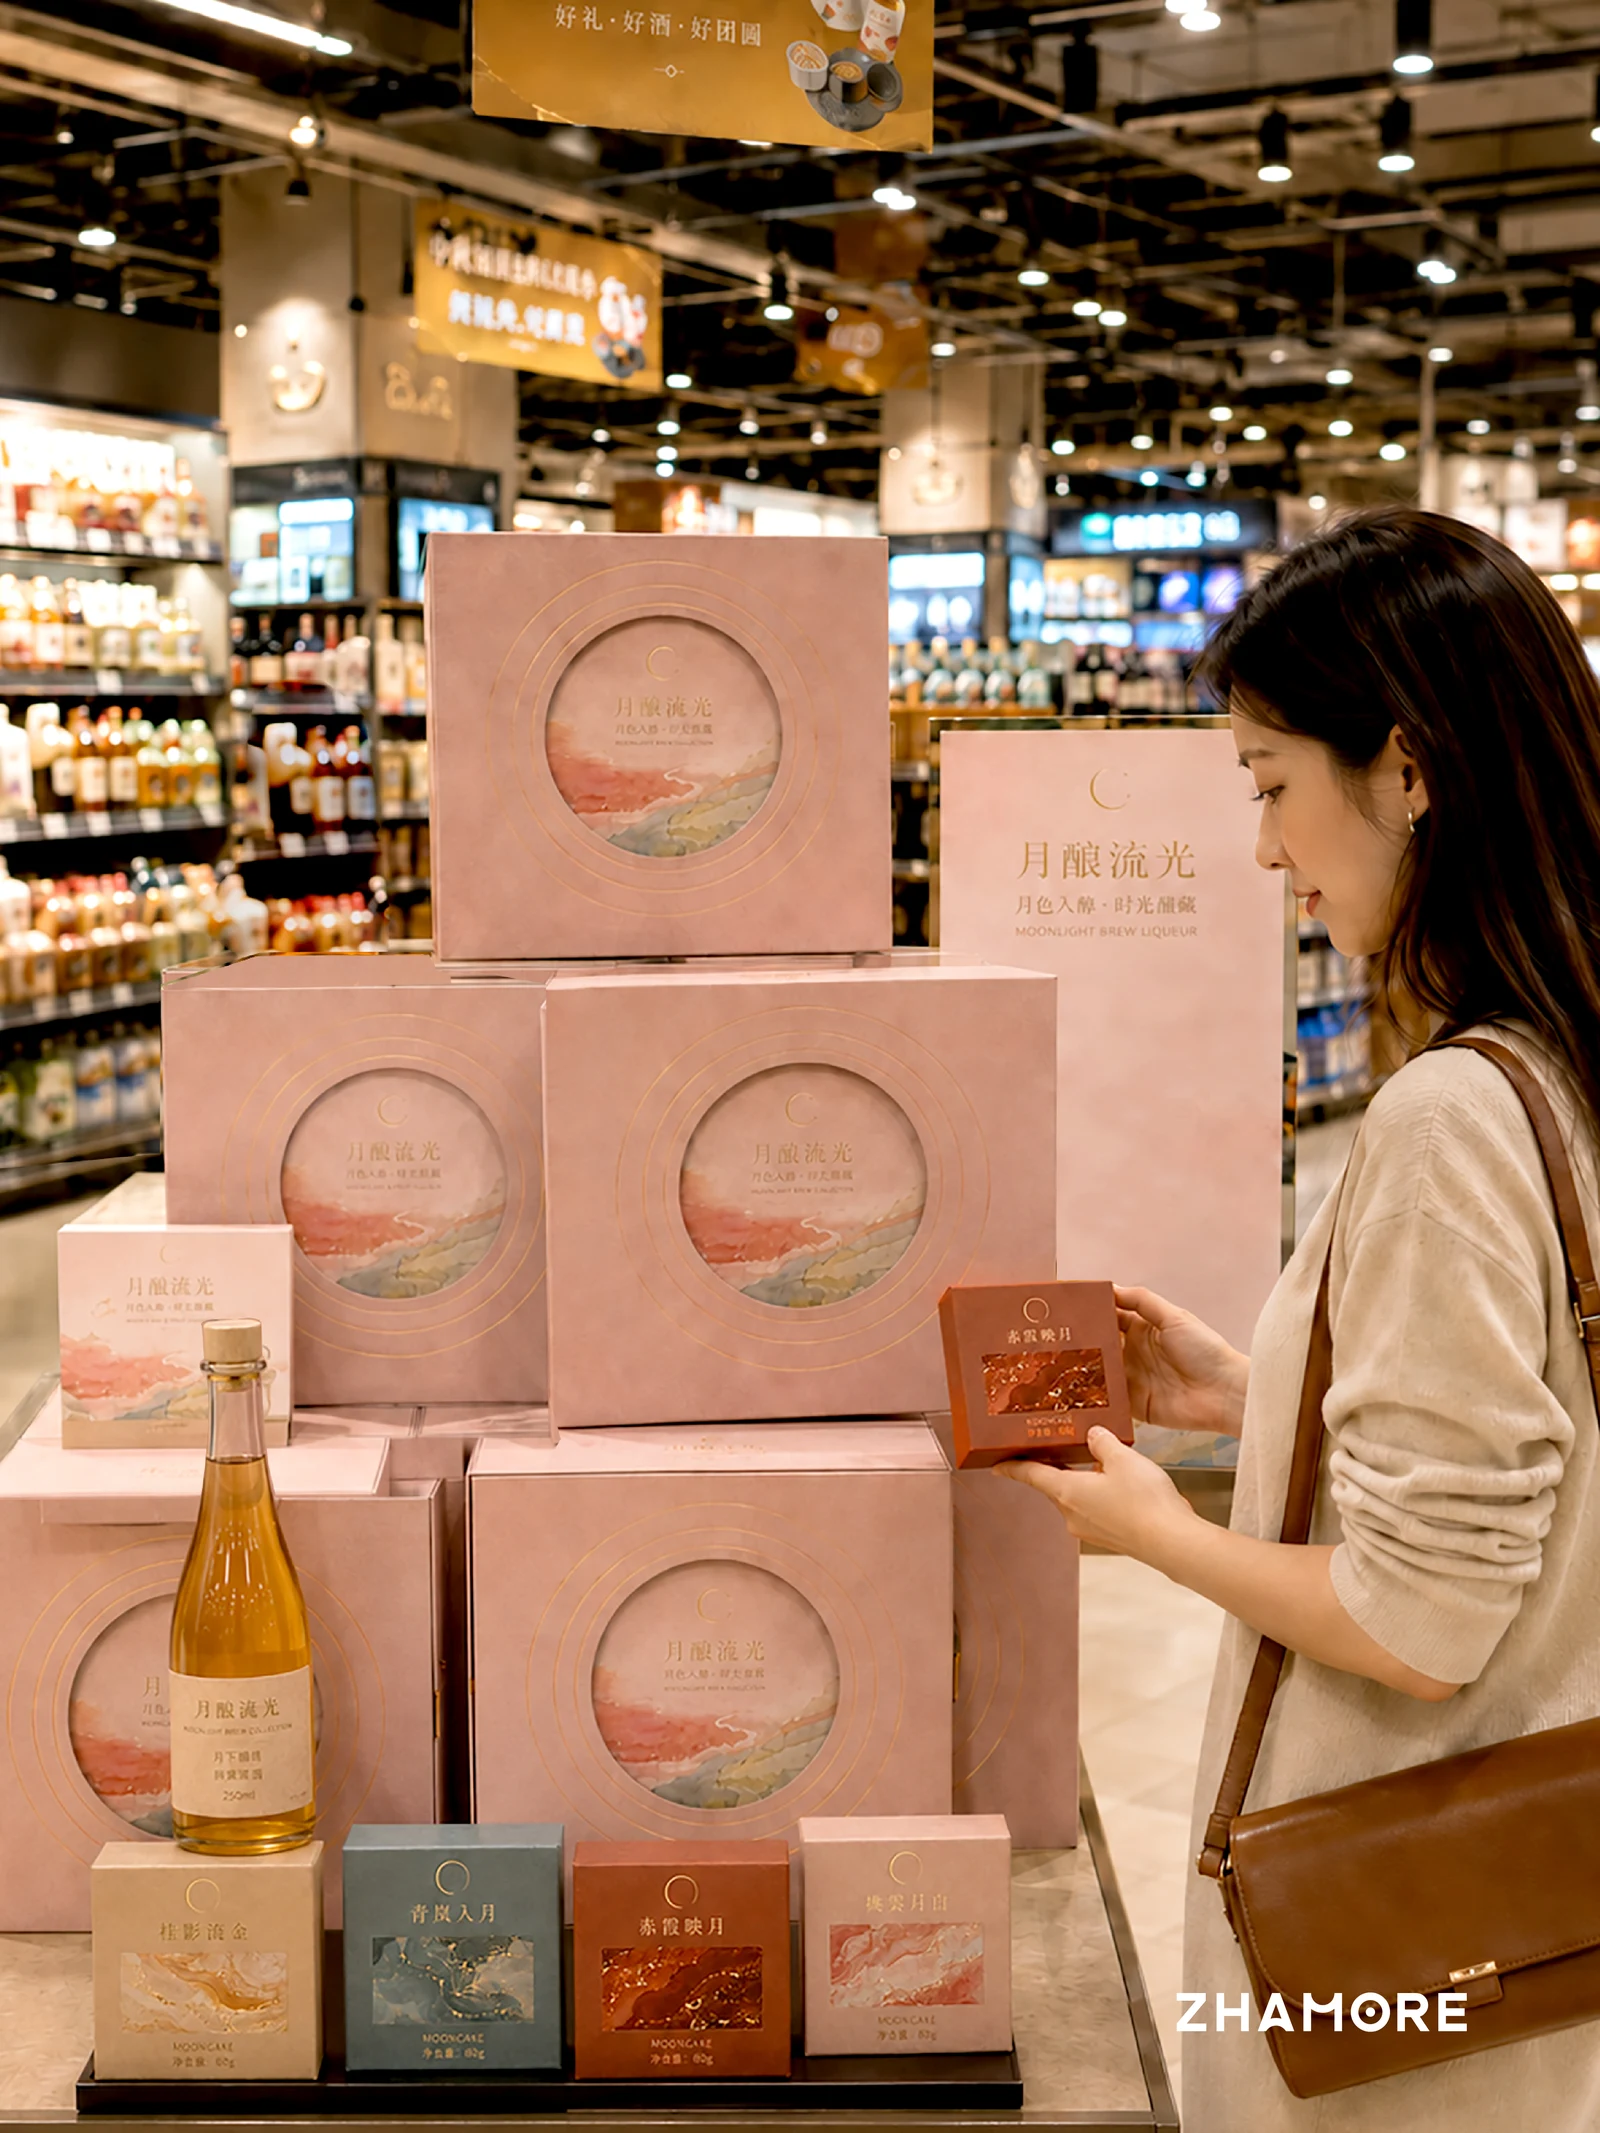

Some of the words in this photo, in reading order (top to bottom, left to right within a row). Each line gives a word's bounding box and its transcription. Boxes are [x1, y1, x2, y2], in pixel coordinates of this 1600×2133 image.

[1017, 840, 1196, 880] 月酿流光
[1015, 926, 1095, 938] MOONLIGHT
[1099, 926, 1137, 938] BREW
[1141, 926, 1198, 939] LIQUEUR
